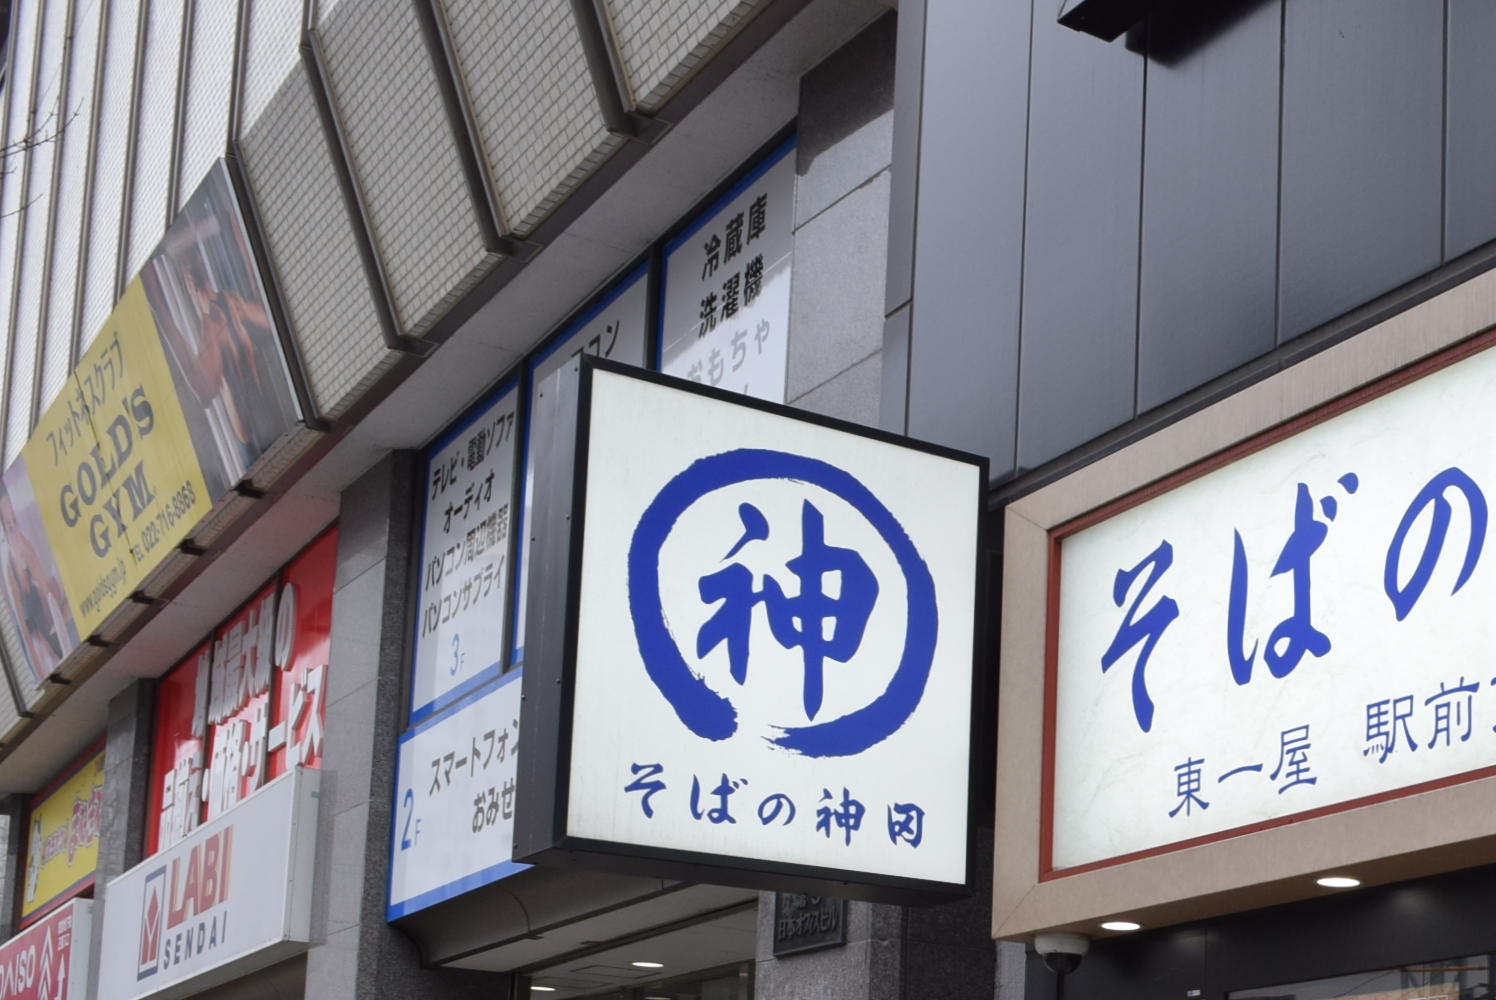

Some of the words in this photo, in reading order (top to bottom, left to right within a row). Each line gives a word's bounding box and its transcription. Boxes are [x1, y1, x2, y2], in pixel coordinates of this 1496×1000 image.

[702, 194, 767, 281] 冷蔵庫
[699, 254, 763, 339] 洗濯機
[60, 384, 154, 528] GOLD'S
[89, 460, 153, 558] GYM
[444, 469, 495, 533] オーディオ
[422, 555, 505, 638] パソコンサプライ
[697, 499, 880, 722] 神
[624, 762, 925, 849] そばの神田
[1168, 723, 1317, 817] 東一屋
[167, 824, 236, 930] LABI
[163, 911, 228, 971] SENDAI
